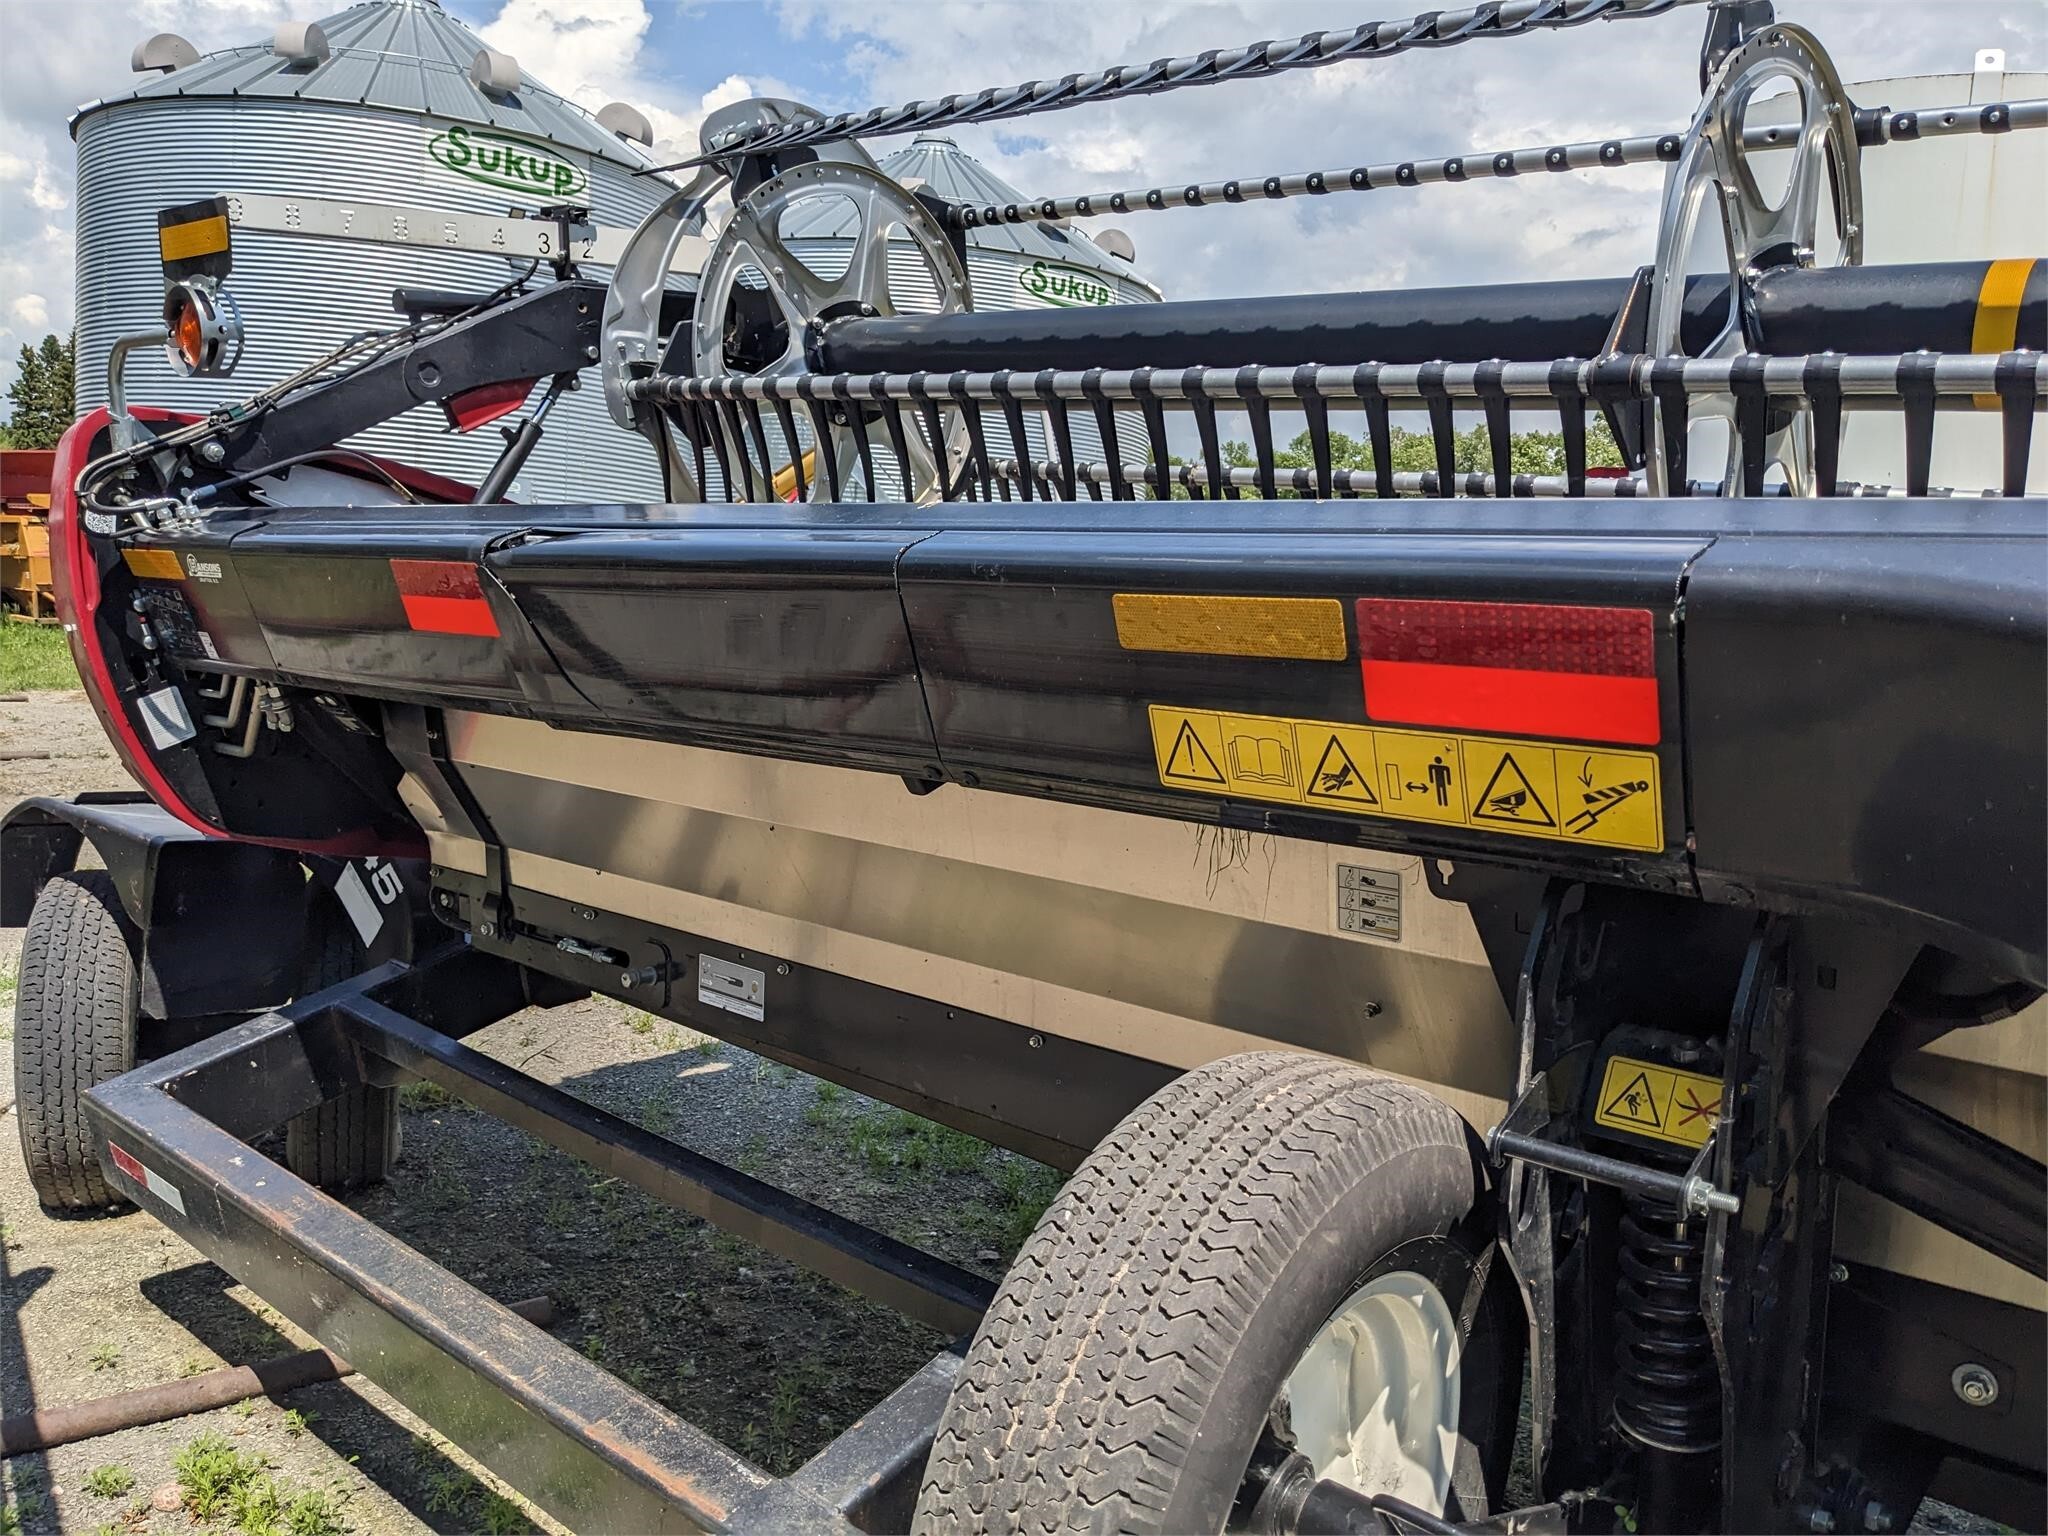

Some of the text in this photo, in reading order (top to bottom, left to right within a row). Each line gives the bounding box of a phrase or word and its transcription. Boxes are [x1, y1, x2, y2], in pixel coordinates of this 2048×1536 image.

[446, 126, 573, 196] Sukup
[286, 203, 301, 229] 8
[339, 209, 355, 234] 7
[393, 215, 409, 240] 6
[444, 221, 459, 246] 5
[491, 227, 506, 250] 4
[538, 232, 551, 254] 3
[582, 237, 595, 259] 2
[1031, 261, 1109, 305] Sukup
